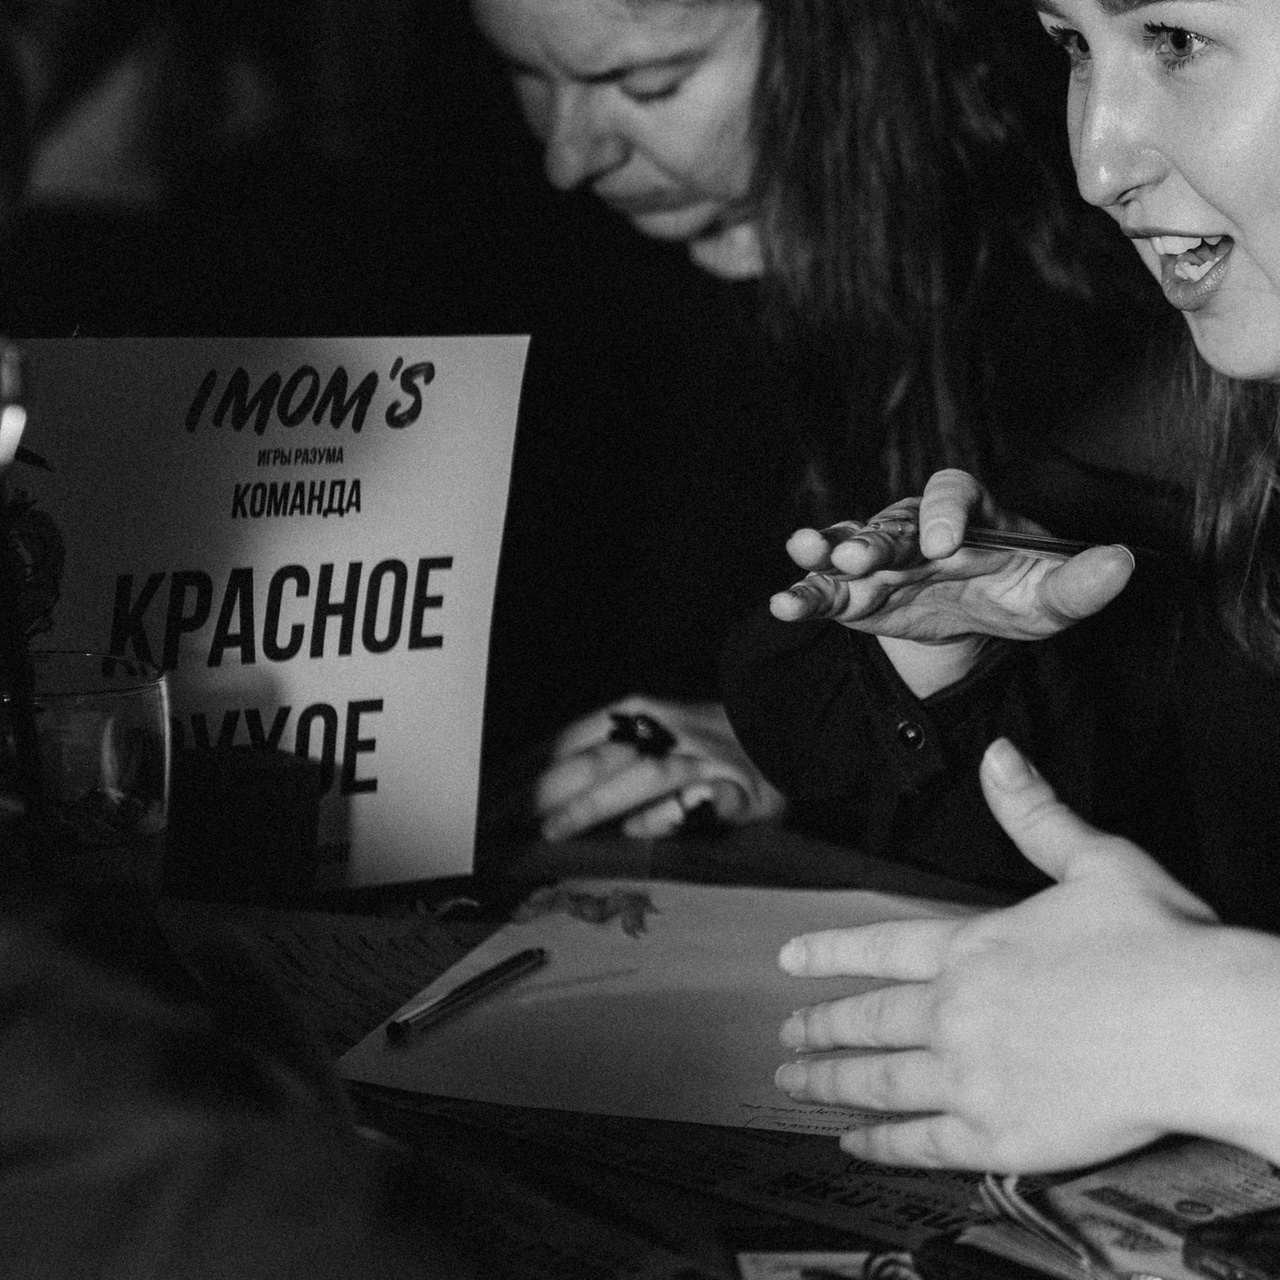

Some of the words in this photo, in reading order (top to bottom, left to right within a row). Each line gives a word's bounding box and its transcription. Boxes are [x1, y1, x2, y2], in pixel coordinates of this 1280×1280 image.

[257, 449, 292, 467] ИГРЫ
[294, 446, 344, 465] РАЗУМА
[231, 479, 362, 519] КОМАНДА
[101, 556, 453, 677] КРАСНОЕ
